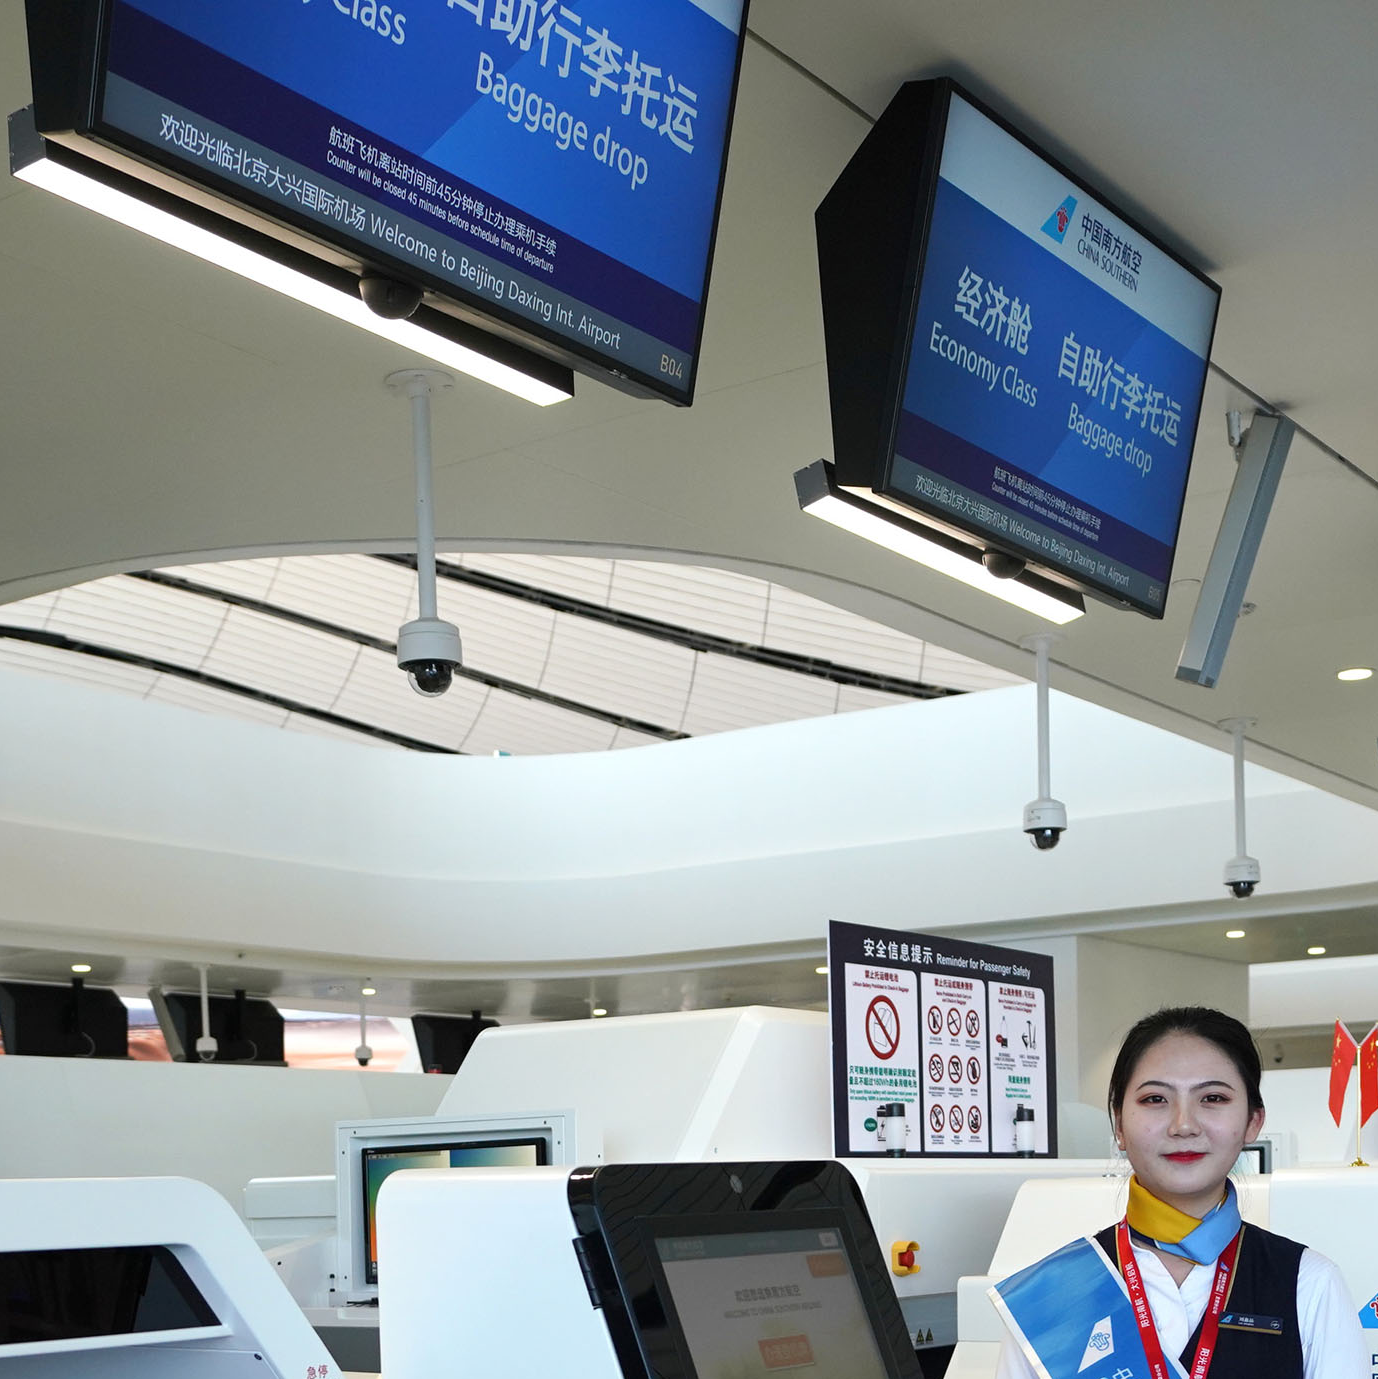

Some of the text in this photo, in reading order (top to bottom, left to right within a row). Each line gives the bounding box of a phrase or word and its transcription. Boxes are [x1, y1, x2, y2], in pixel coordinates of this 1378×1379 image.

[447, 0, 699, 154] 助行李托运
[475, 51, 650, 191] Baggage drop
[159, 113, 621, 351] 欢迎光临北京大兴国际机场 Welcome to Beijing Daxing Int. Airport
[326, 149, 555, 274] Counter will be closed 45 minutes before schedule time of departure
[328, 125, 557, 257] 航班飞机离站时间前45分钟停止办理乘机手续
[1081, 212, 1143, 275] 中国南方航空
[1077, 238, 1139, 293] CHINA SOUTHERN
[659, 352, 684, 380] B04
[929, 321, 1153, 479] Economy Class Baggage drop
[954, 265, 1182, 447] 经济舱 自助行李托运
[1008, 518, 1042, 546] Welcome
[1041, 536, 1050, 550] to
[1050, 538, 1073, 564] Beijing
[1073, 549, 1097, 574] Daxing
[1107, 566, 1131, 587] Airport
[863, 937, 1031, 981] 安全信息提示 Reminder for Passenger Safety
[306, 1364, 329, 1379] 急停
